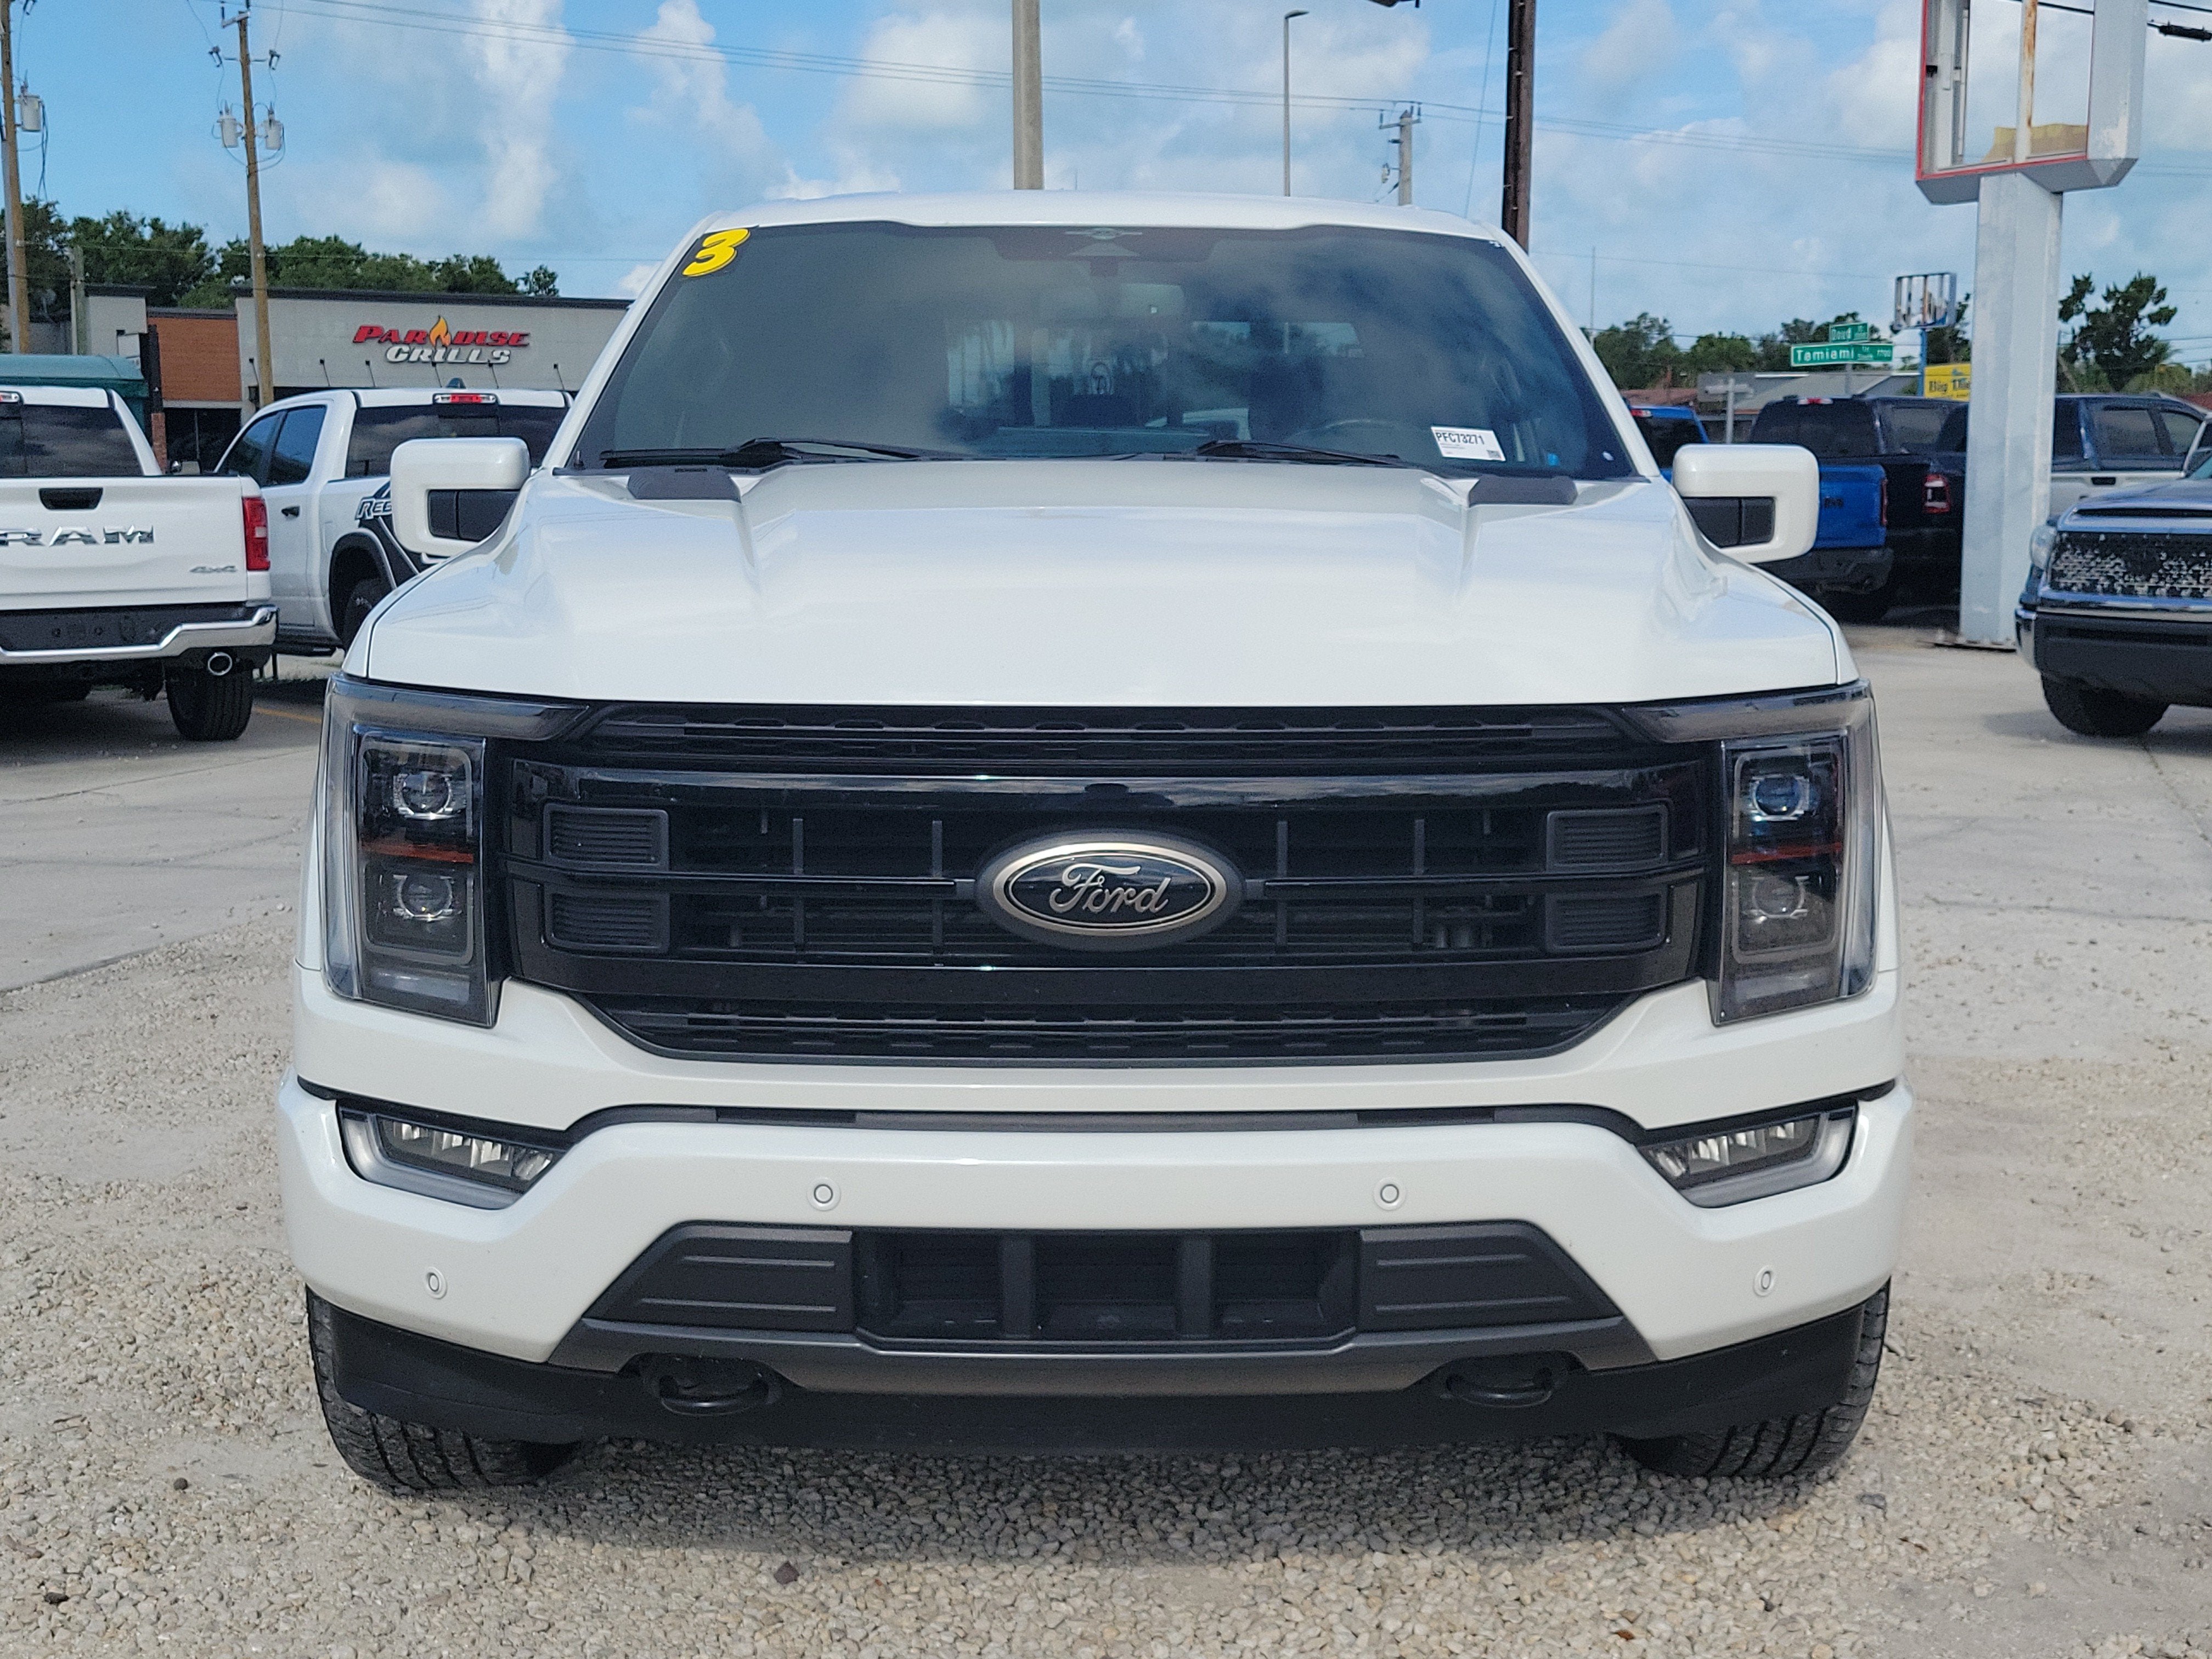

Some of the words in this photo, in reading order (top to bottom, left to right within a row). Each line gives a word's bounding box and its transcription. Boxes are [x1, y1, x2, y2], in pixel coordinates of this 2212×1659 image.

[682, 228, 751, 278] 3
[386, 344, 511, 364] GRILLS
[1796, 347, 1854, 364] Tamiami
[1436, 432, 1485, 445] PFC73271
[0, 525, 154, 546] RAM
[1049, 862, 1172, 913] Ford
